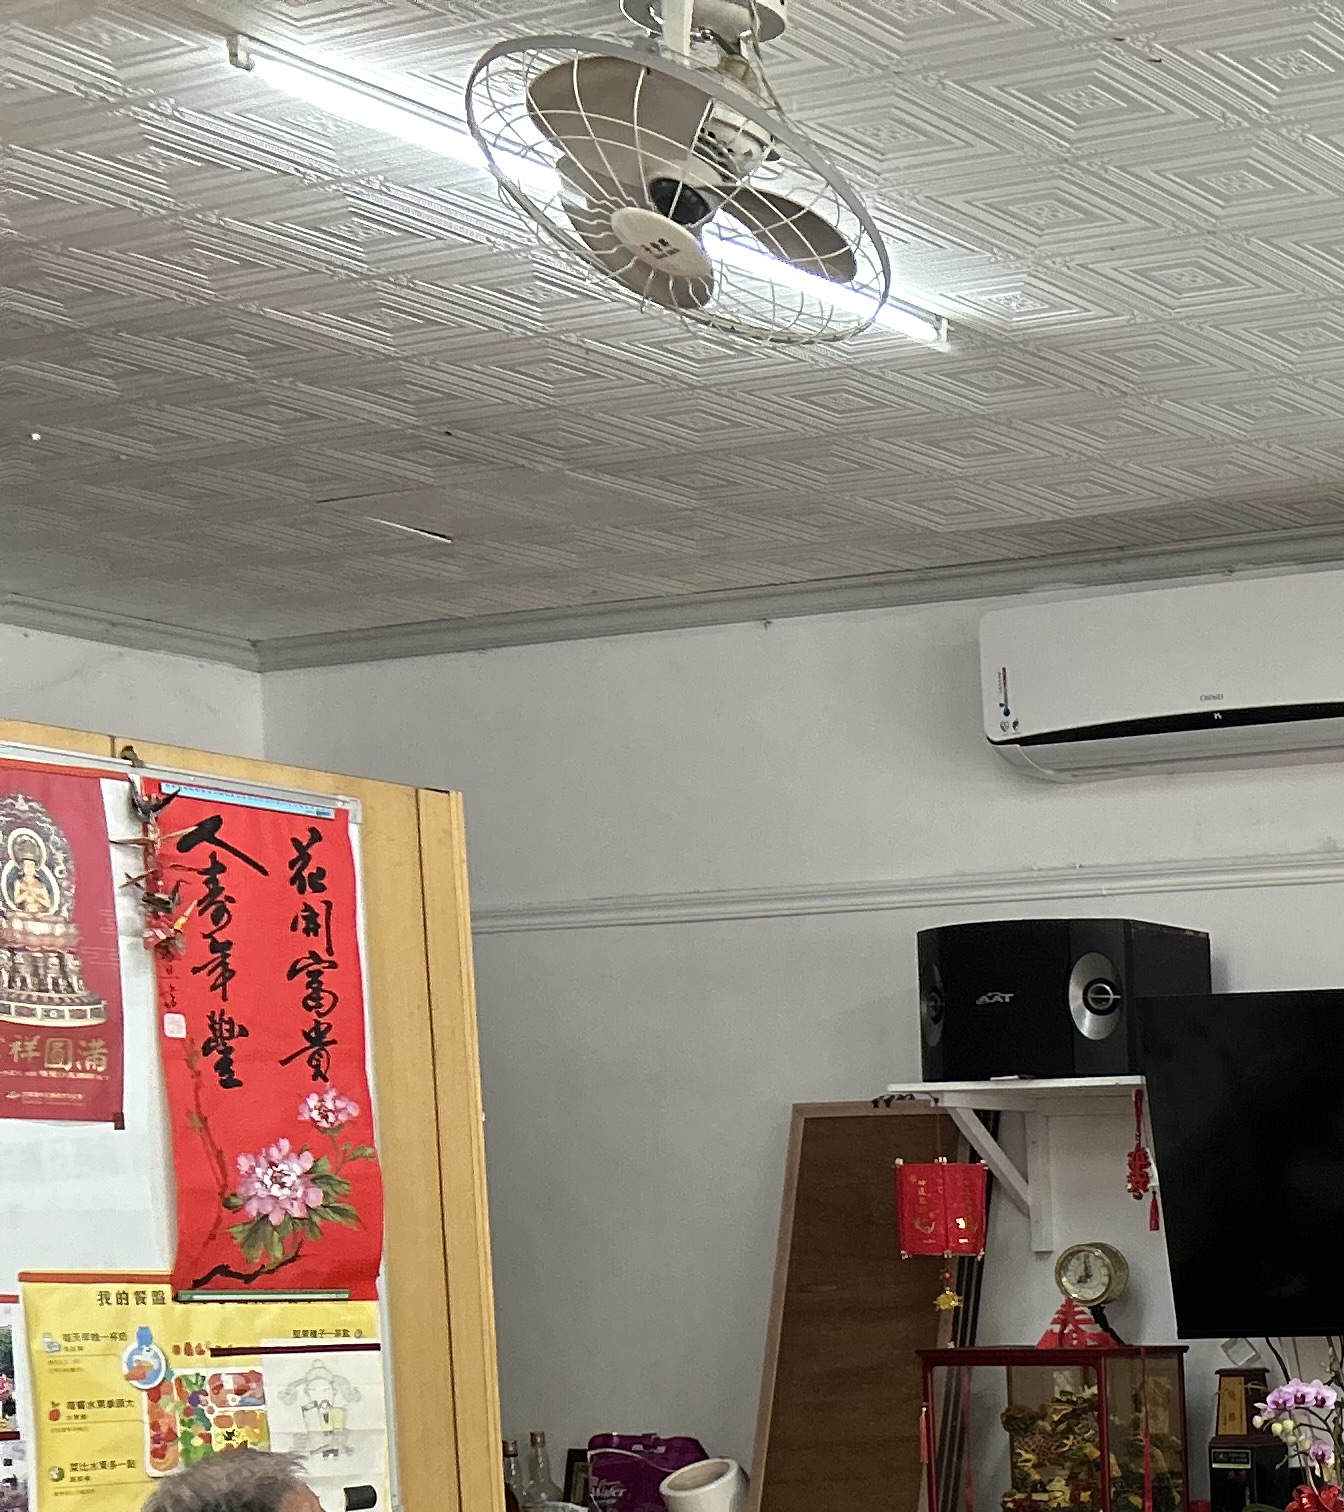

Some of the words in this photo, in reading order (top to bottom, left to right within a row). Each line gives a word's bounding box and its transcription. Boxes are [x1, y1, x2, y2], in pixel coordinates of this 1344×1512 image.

[279, 826, 339, 1083] 花開富貴
[0, 1033, 110, 1072] 祥圓滿
